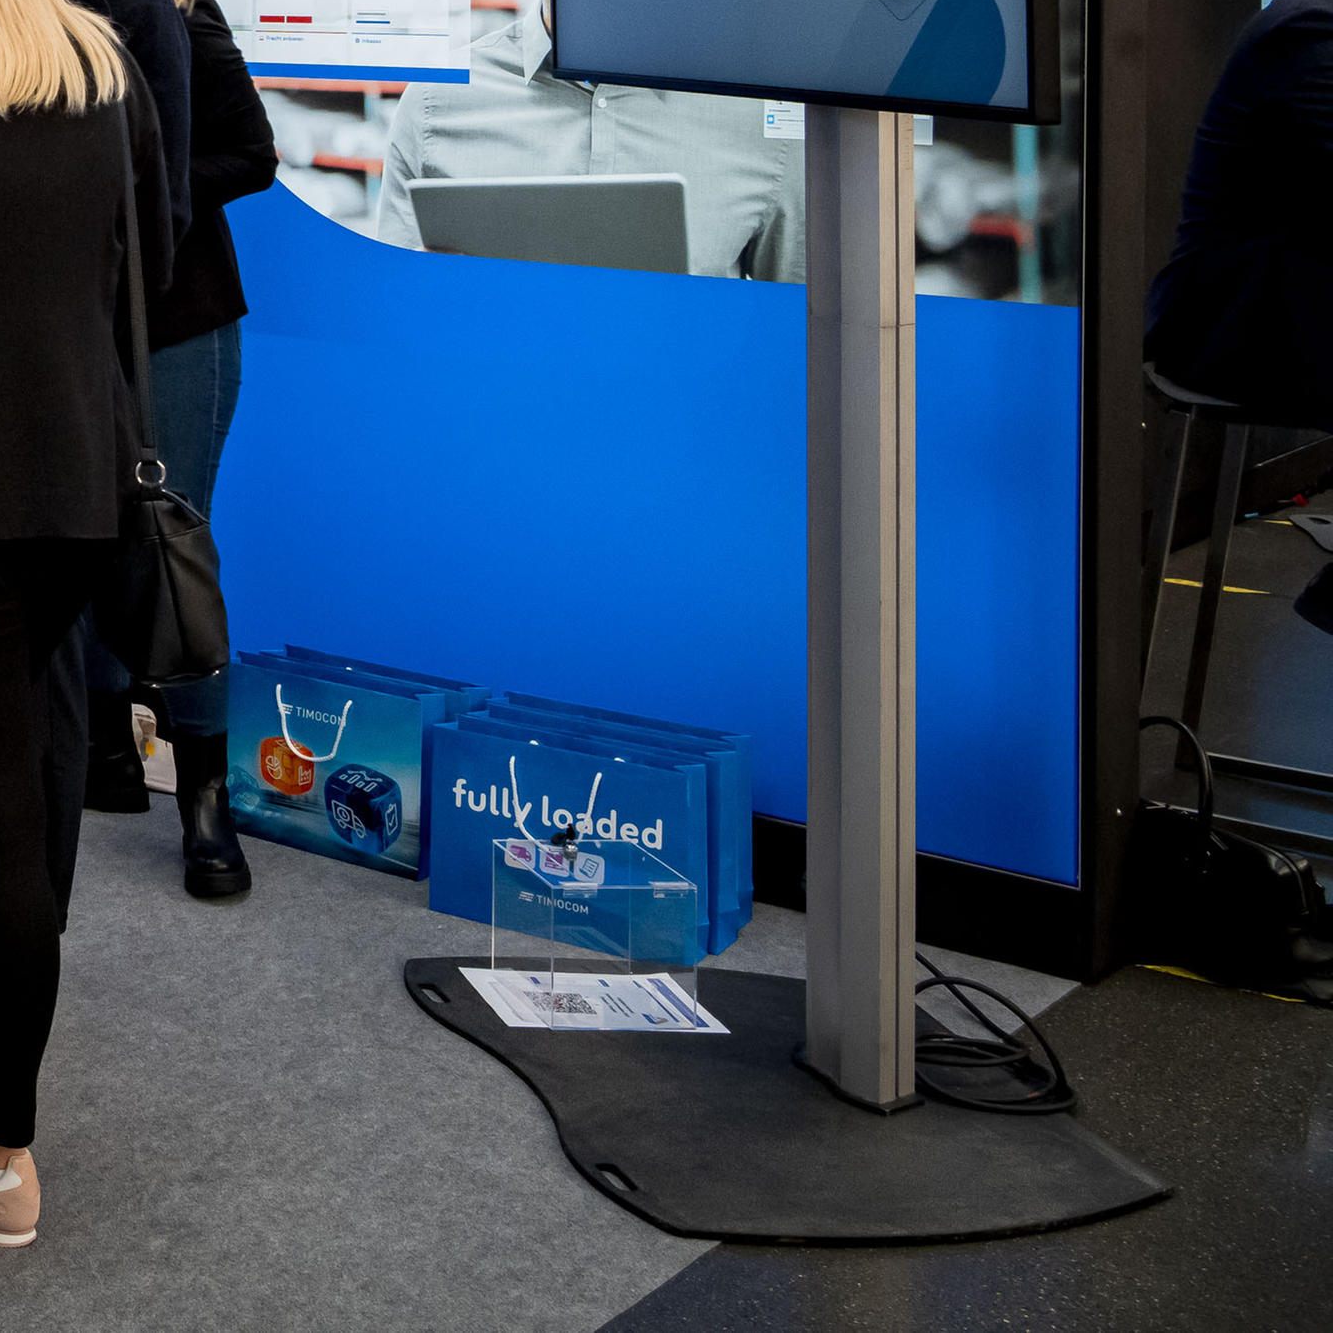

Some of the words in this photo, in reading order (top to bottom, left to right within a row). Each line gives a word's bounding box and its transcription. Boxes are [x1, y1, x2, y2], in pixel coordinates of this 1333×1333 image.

[452, 778, 532, 828] fully
[541, 794, 663, 850] loaded
[536, 894, 589, 916] TIMOCOM
